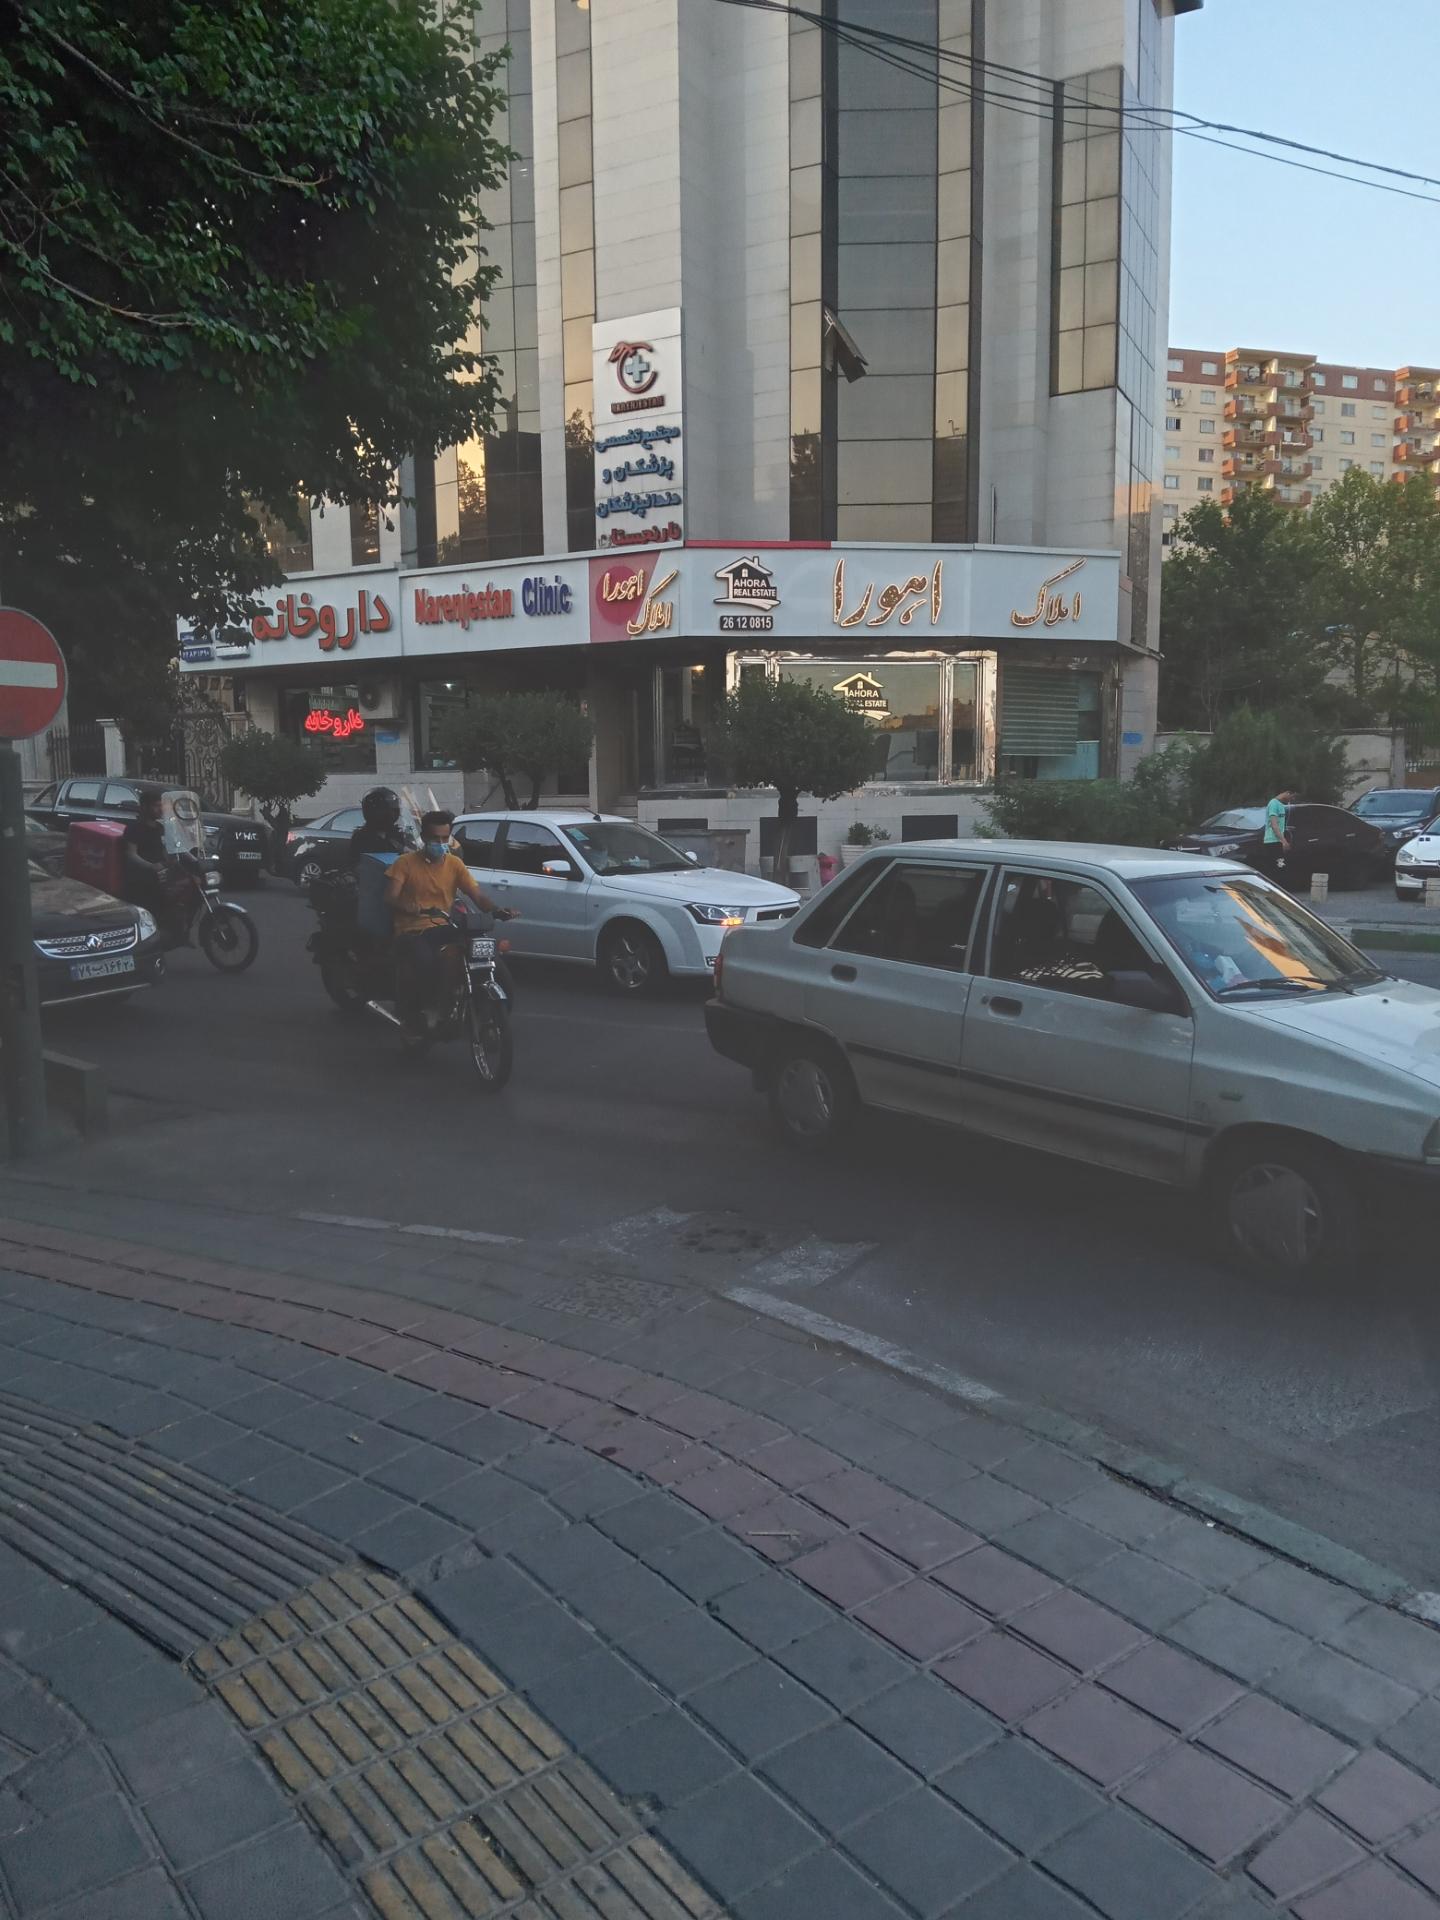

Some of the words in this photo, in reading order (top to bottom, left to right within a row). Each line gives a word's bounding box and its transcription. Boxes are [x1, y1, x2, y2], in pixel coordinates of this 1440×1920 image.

[602, 467, 613, 484] و
[613, 454, 673, 483] پزشکان
[734, 579, 767, 588] AHORA
[1011, 557, 1087, 627] املاک
[734, 588, 752, 597] REAL
[752, 588, 776, 597] ESTATE
[415, 582, 514, 630] Narenjestan
[522, 575, 573, 616] Clinic
[252, 589, 394, 651] داروخانه
[723, 617, 734, 628] 26
[737, 617, 747, 628] 12
[749, 616, 772, 629] 0815
[848, 689, 879, 697] AHORA
[864, 699, 887, 707] ESTATE
[305, 709, 365, 737] داروخانه
